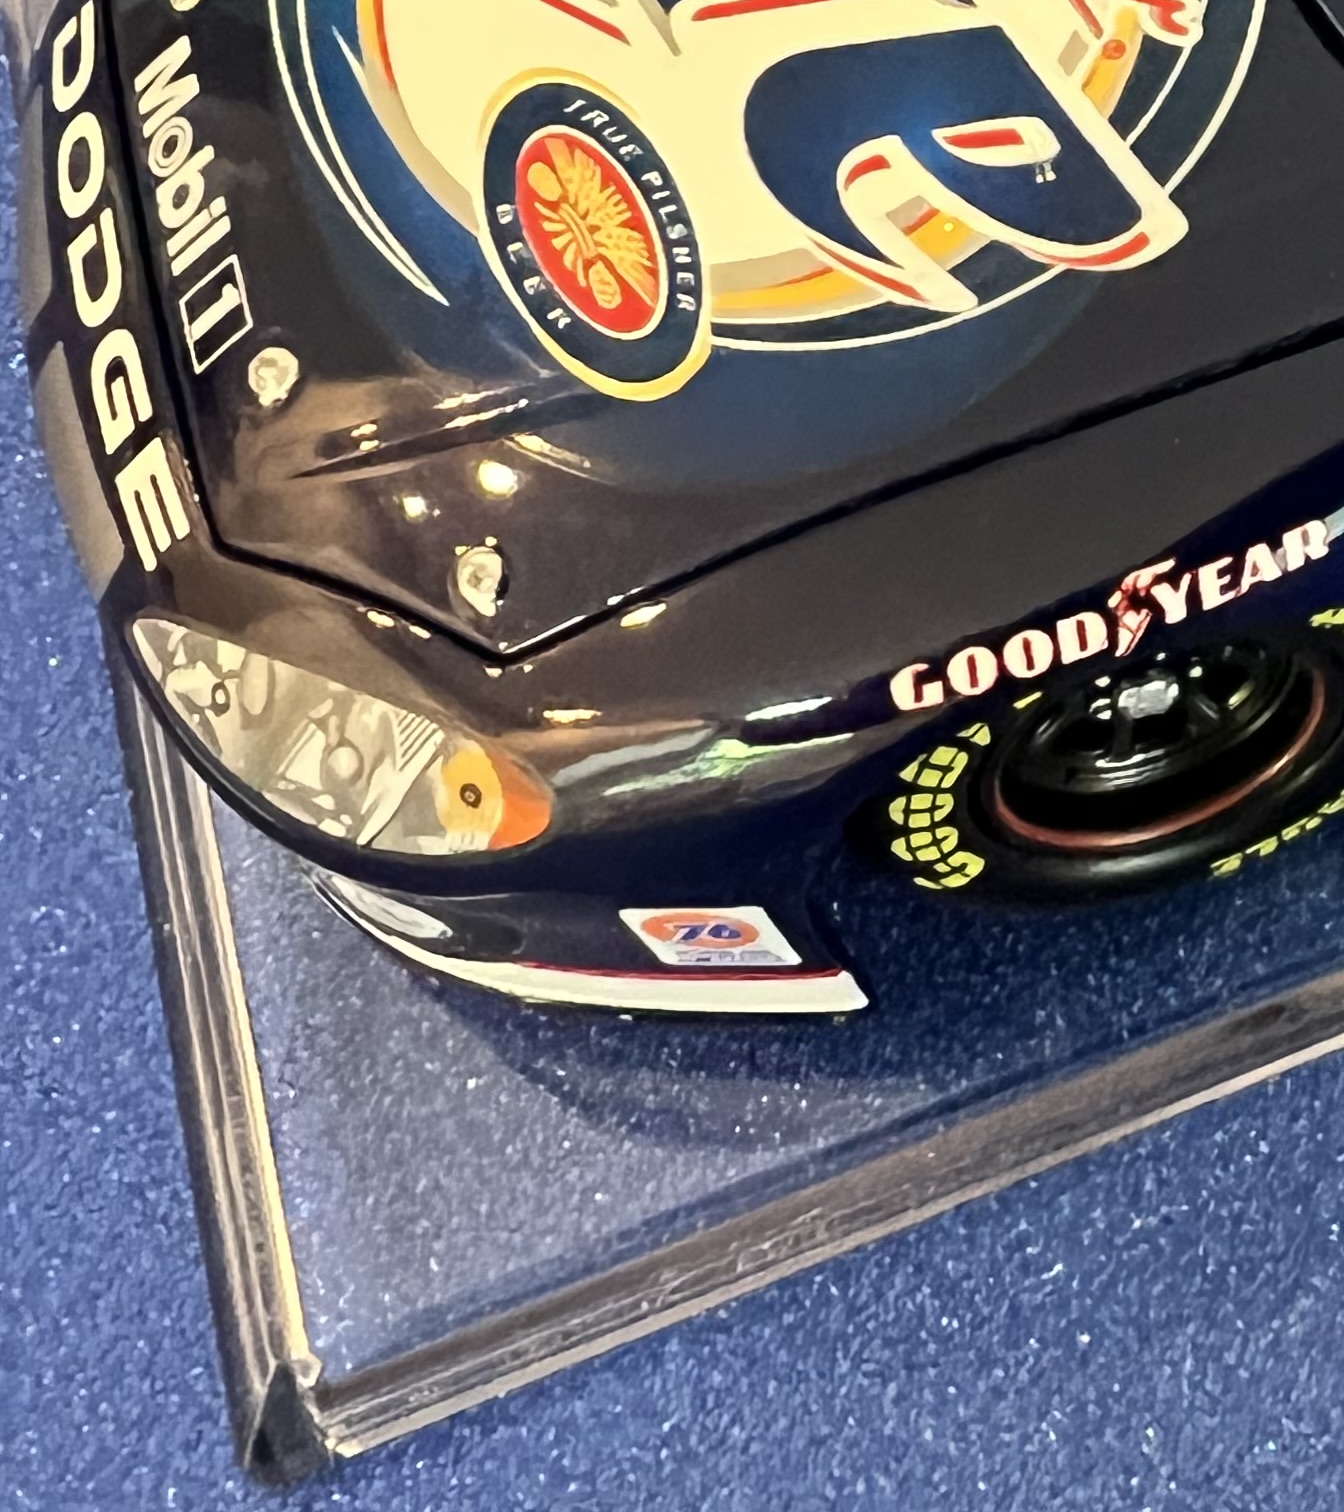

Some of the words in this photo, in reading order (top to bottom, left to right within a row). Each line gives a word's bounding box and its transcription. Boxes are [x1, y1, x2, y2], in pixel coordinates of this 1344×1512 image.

[134, 34, 232, 277] Mobil
[641, 170, 697, 312] PILSNER
[51, 0, 192, 572] DODGE
[889, 519, 1330, 712] GOODYEAR
